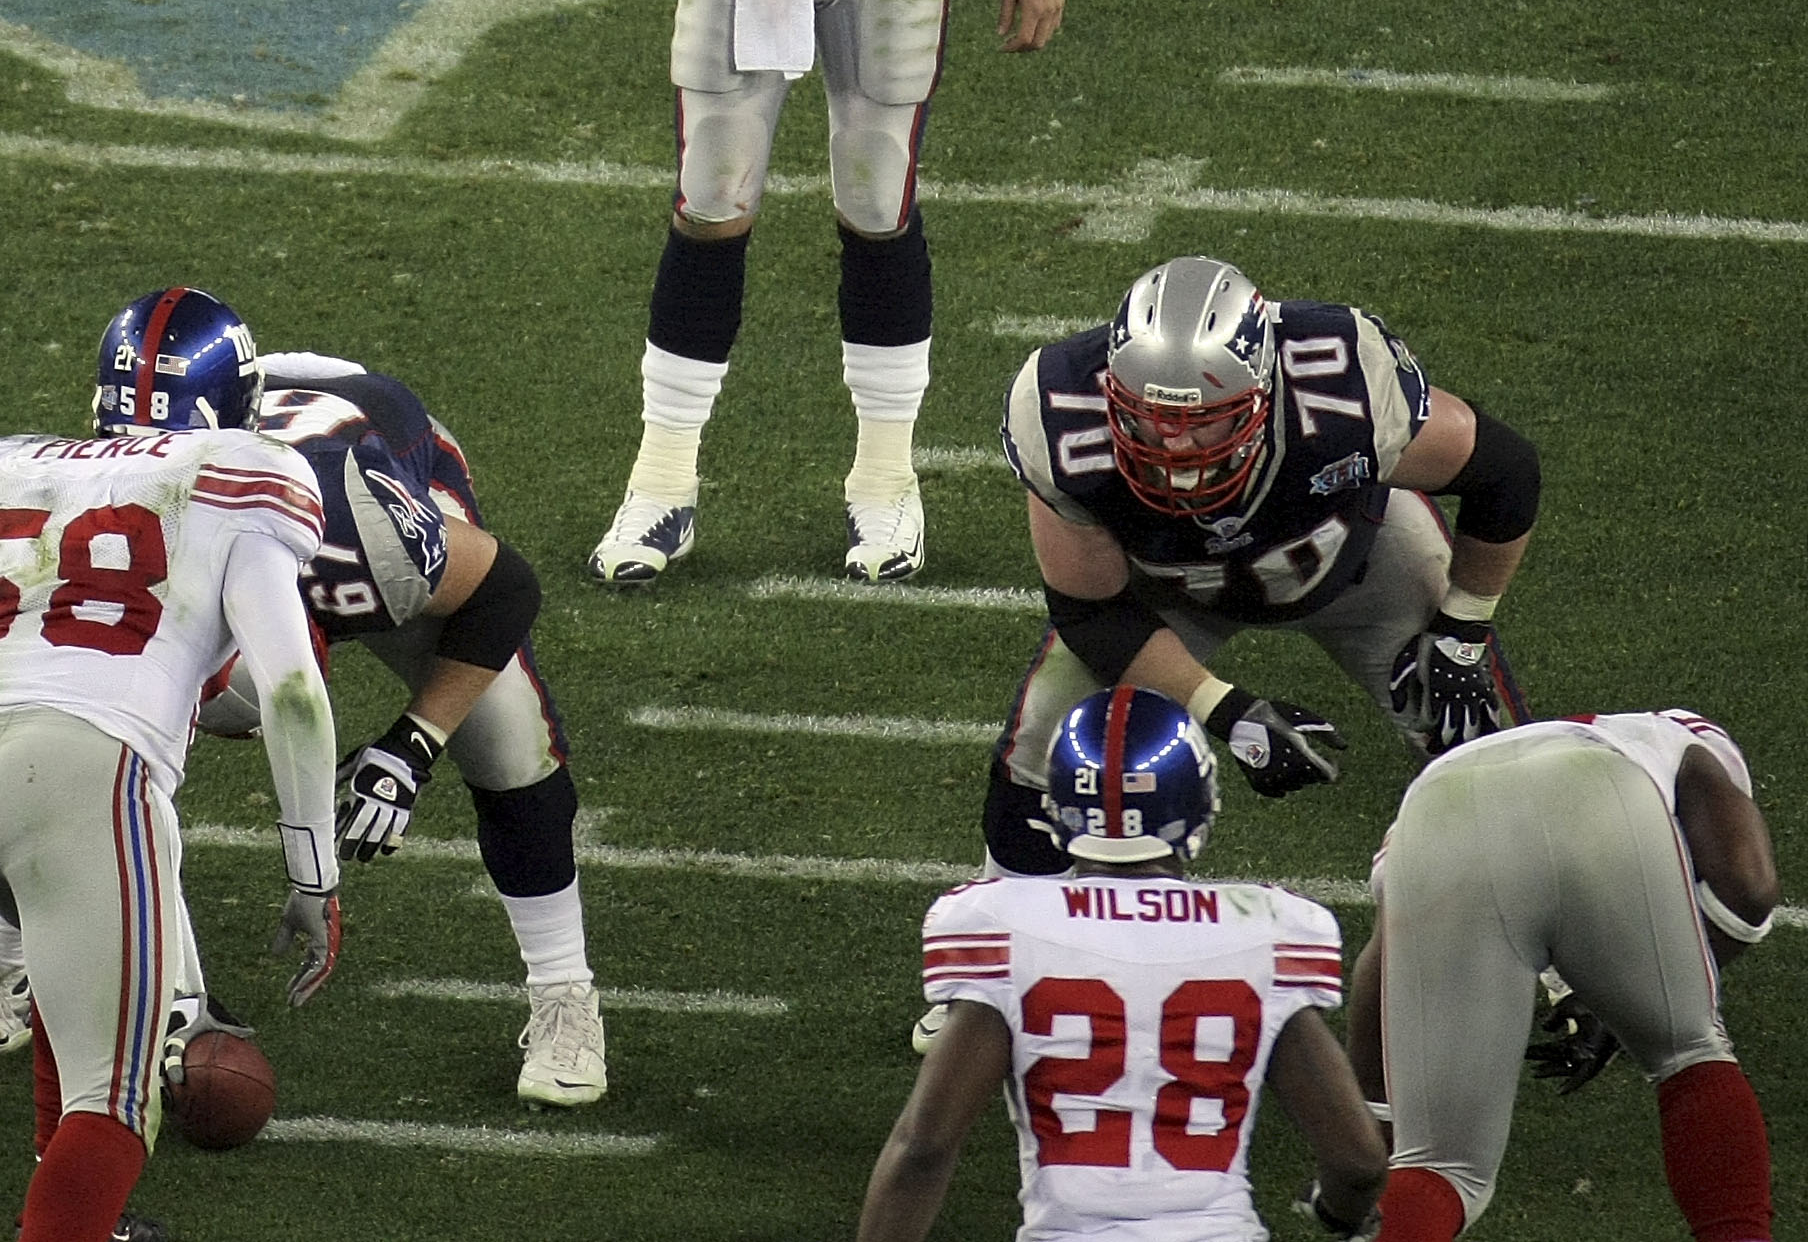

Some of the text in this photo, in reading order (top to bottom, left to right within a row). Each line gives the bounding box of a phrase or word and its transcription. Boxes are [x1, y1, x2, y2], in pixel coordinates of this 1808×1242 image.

[1281, 337, 1366, 439] 70
[32, 432, 194, 460] PIERCE
[1074, 767, 1098, 795] 21
[1061, 885, 1220, 924] WILSON
[1020, 976, 1263, 1173] 28
